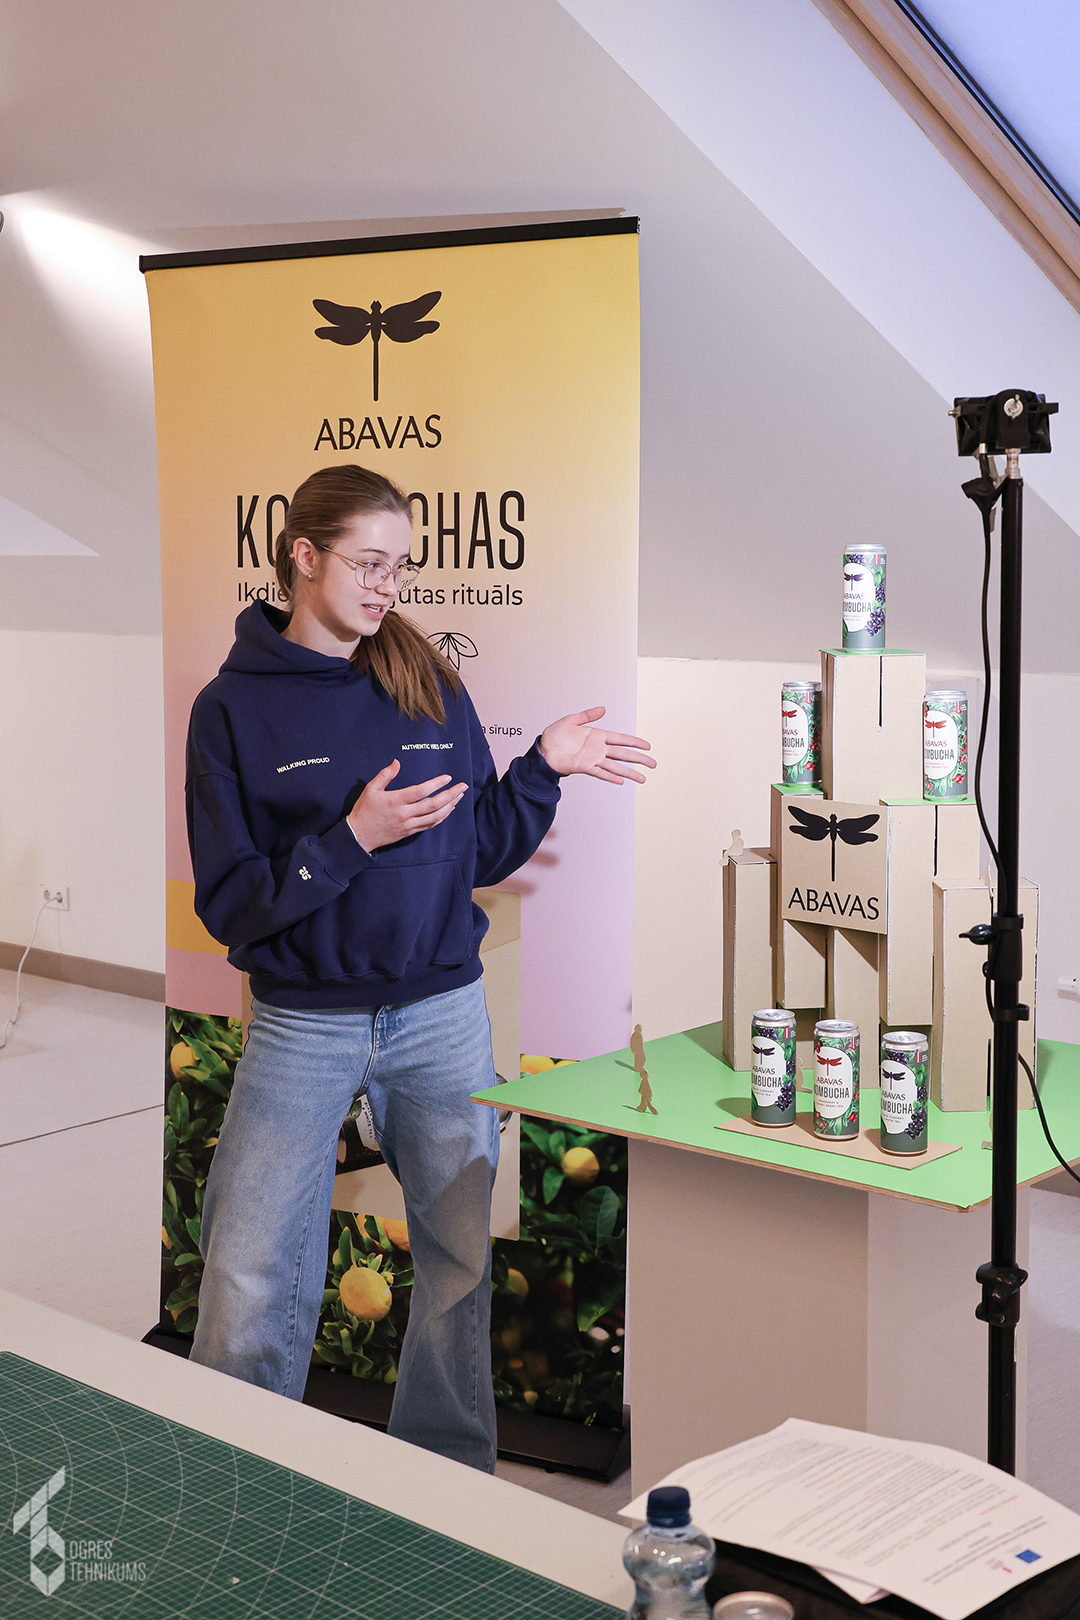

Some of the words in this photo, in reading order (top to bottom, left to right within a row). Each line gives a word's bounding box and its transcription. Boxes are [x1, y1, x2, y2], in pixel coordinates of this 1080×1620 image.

[313, 414, 442, 450] ABAVAS
[237, 490, 525, 570] KOCHAS
[452, 583, 523, 605] rituāls
[489, 724, 522, 737] sīrups
[439, 742, 454, 750] ONLY
[276, 759, 307, 774] WALKING
[307, 757, 330, 765] PROUD
[788, 887, 879, 920] ABAVAS
[816, 1076, 844, 1086] ABAVAS
